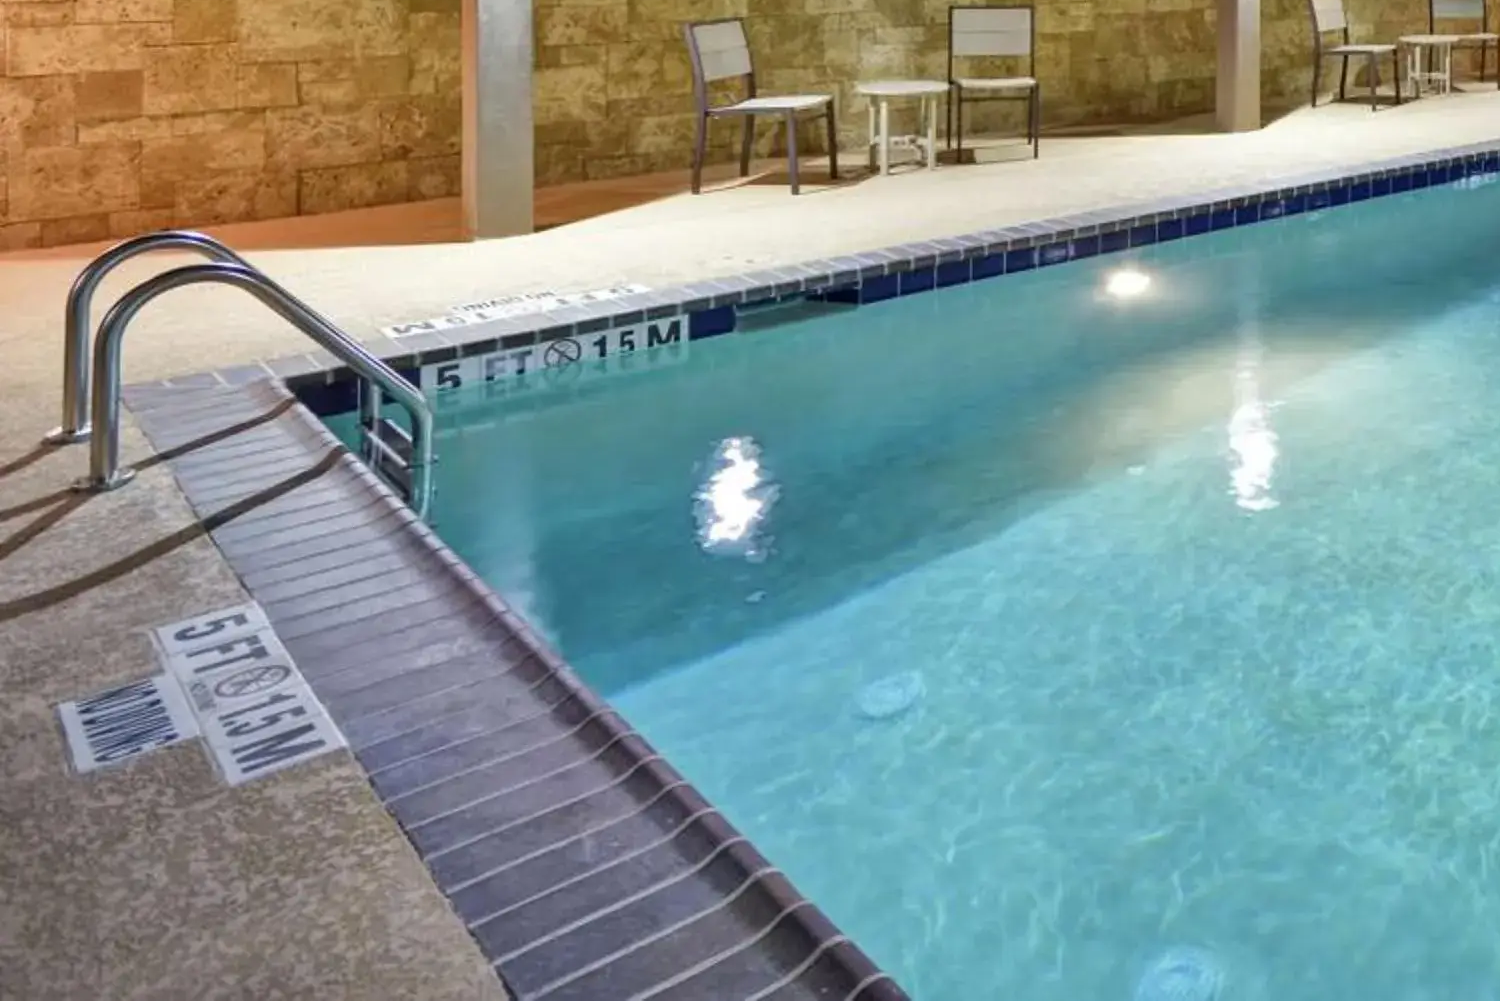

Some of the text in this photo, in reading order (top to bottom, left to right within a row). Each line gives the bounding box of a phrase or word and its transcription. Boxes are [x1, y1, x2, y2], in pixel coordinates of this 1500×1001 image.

[436, 363, 463, 389] 5
[484, 349, 533, 382] FT
[646, 319, 681, 348] M
[173, 612, 248, 641] 5
[186, 635, 270, 674] FT
[230, 722, 327, 774] M
